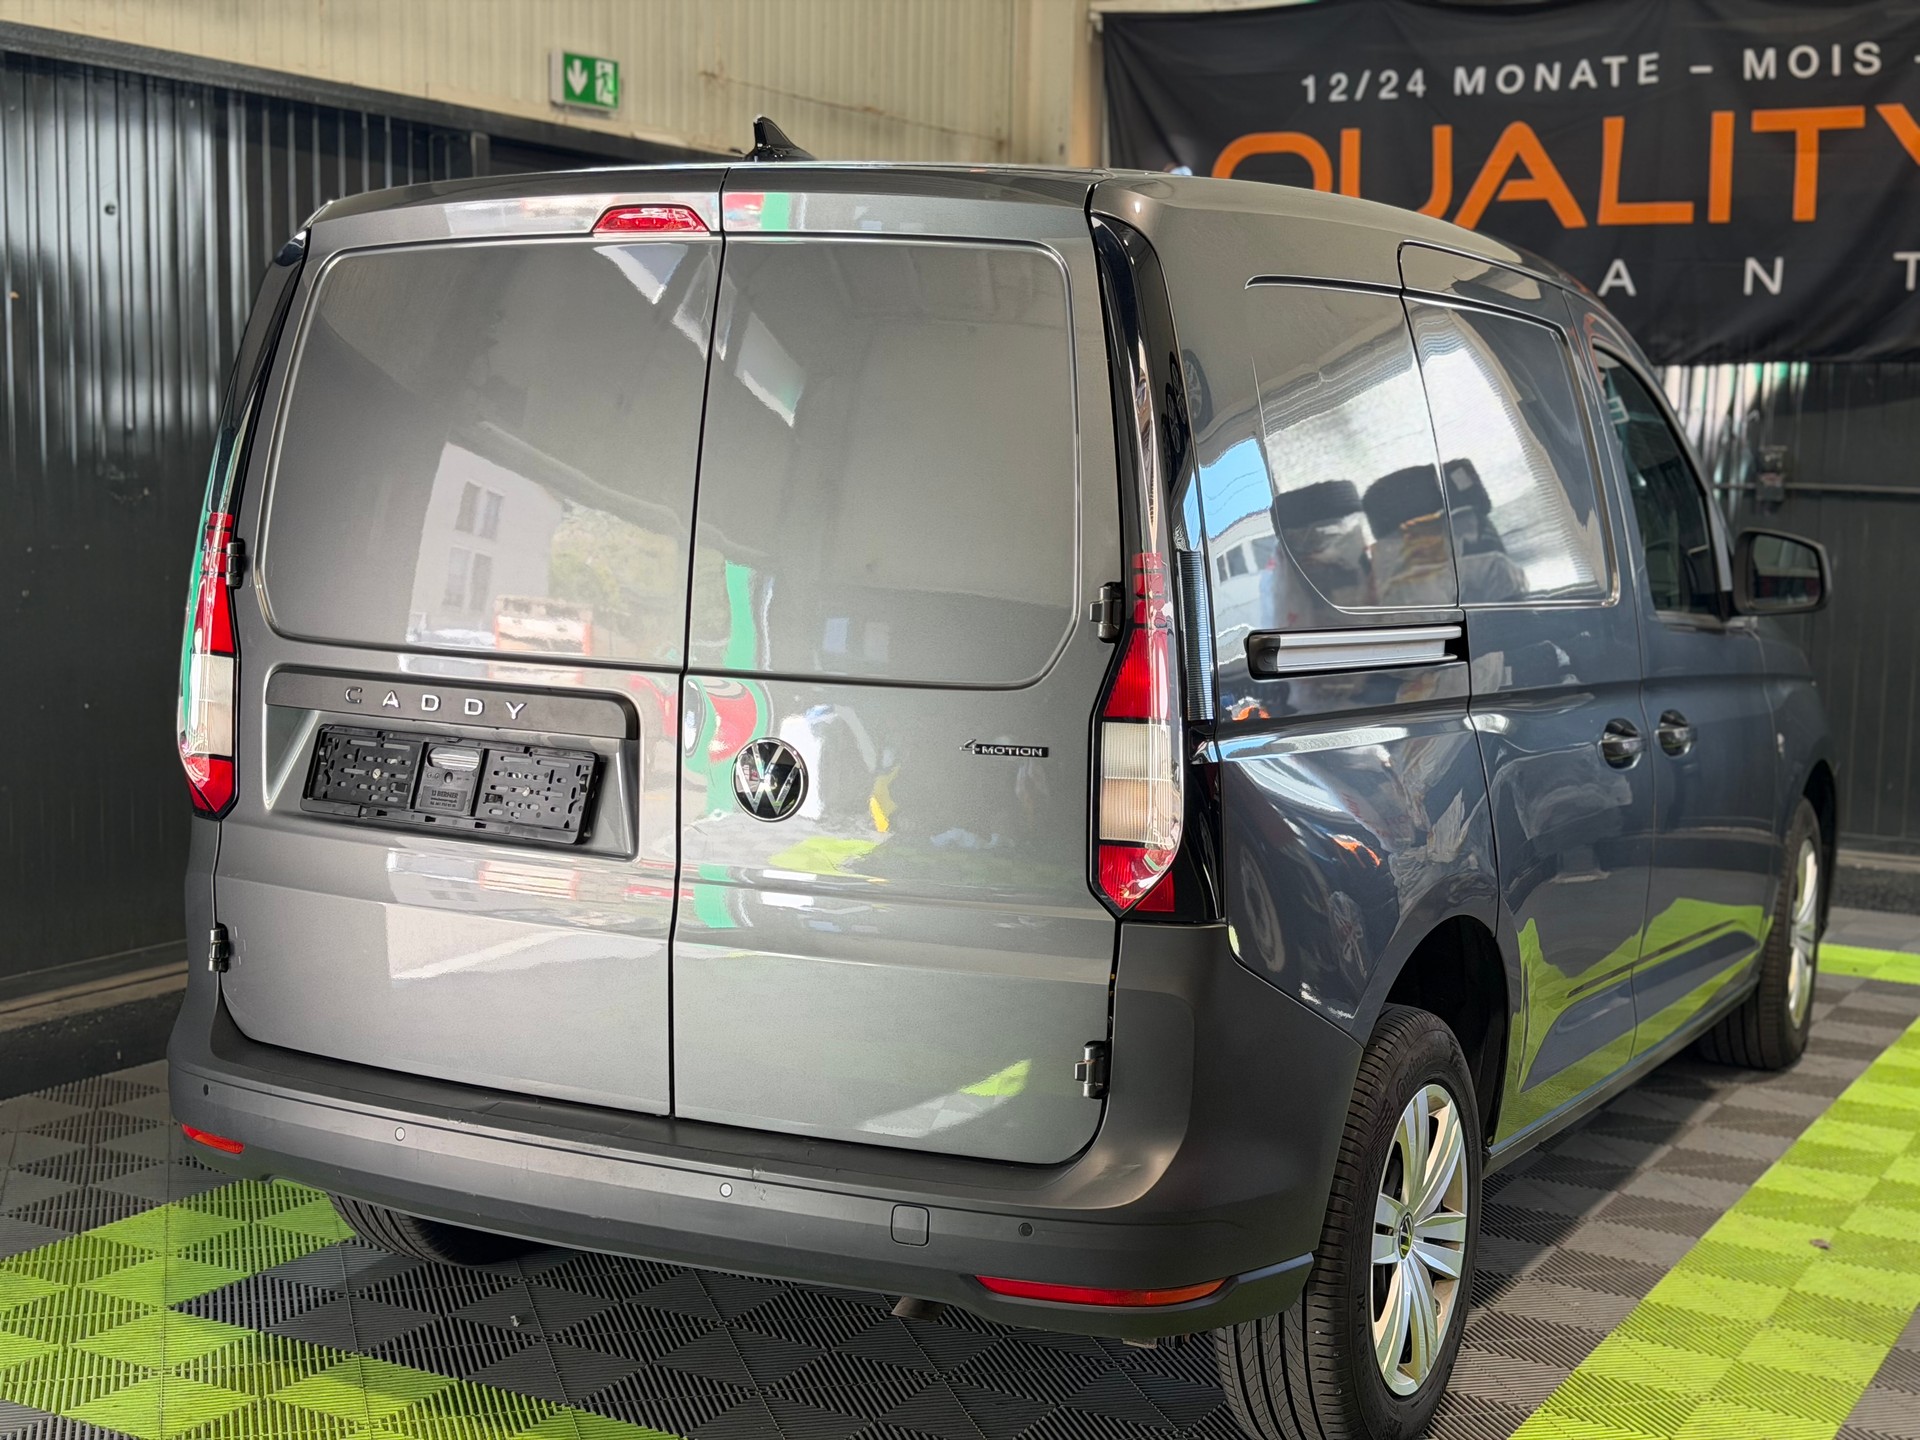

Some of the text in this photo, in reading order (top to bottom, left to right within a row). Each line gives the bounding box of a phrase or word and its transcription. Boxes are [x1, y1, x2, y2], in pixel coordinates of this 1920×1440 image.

[1301, 66, 1426, 104] 12/24
[1453, 52, 1659, 96] MONATE
[1743, 41, 1882, 81] MOIS
[344, 686, 526, 720] CADDY
[959, 739, 1044, 757] 4MOTION
